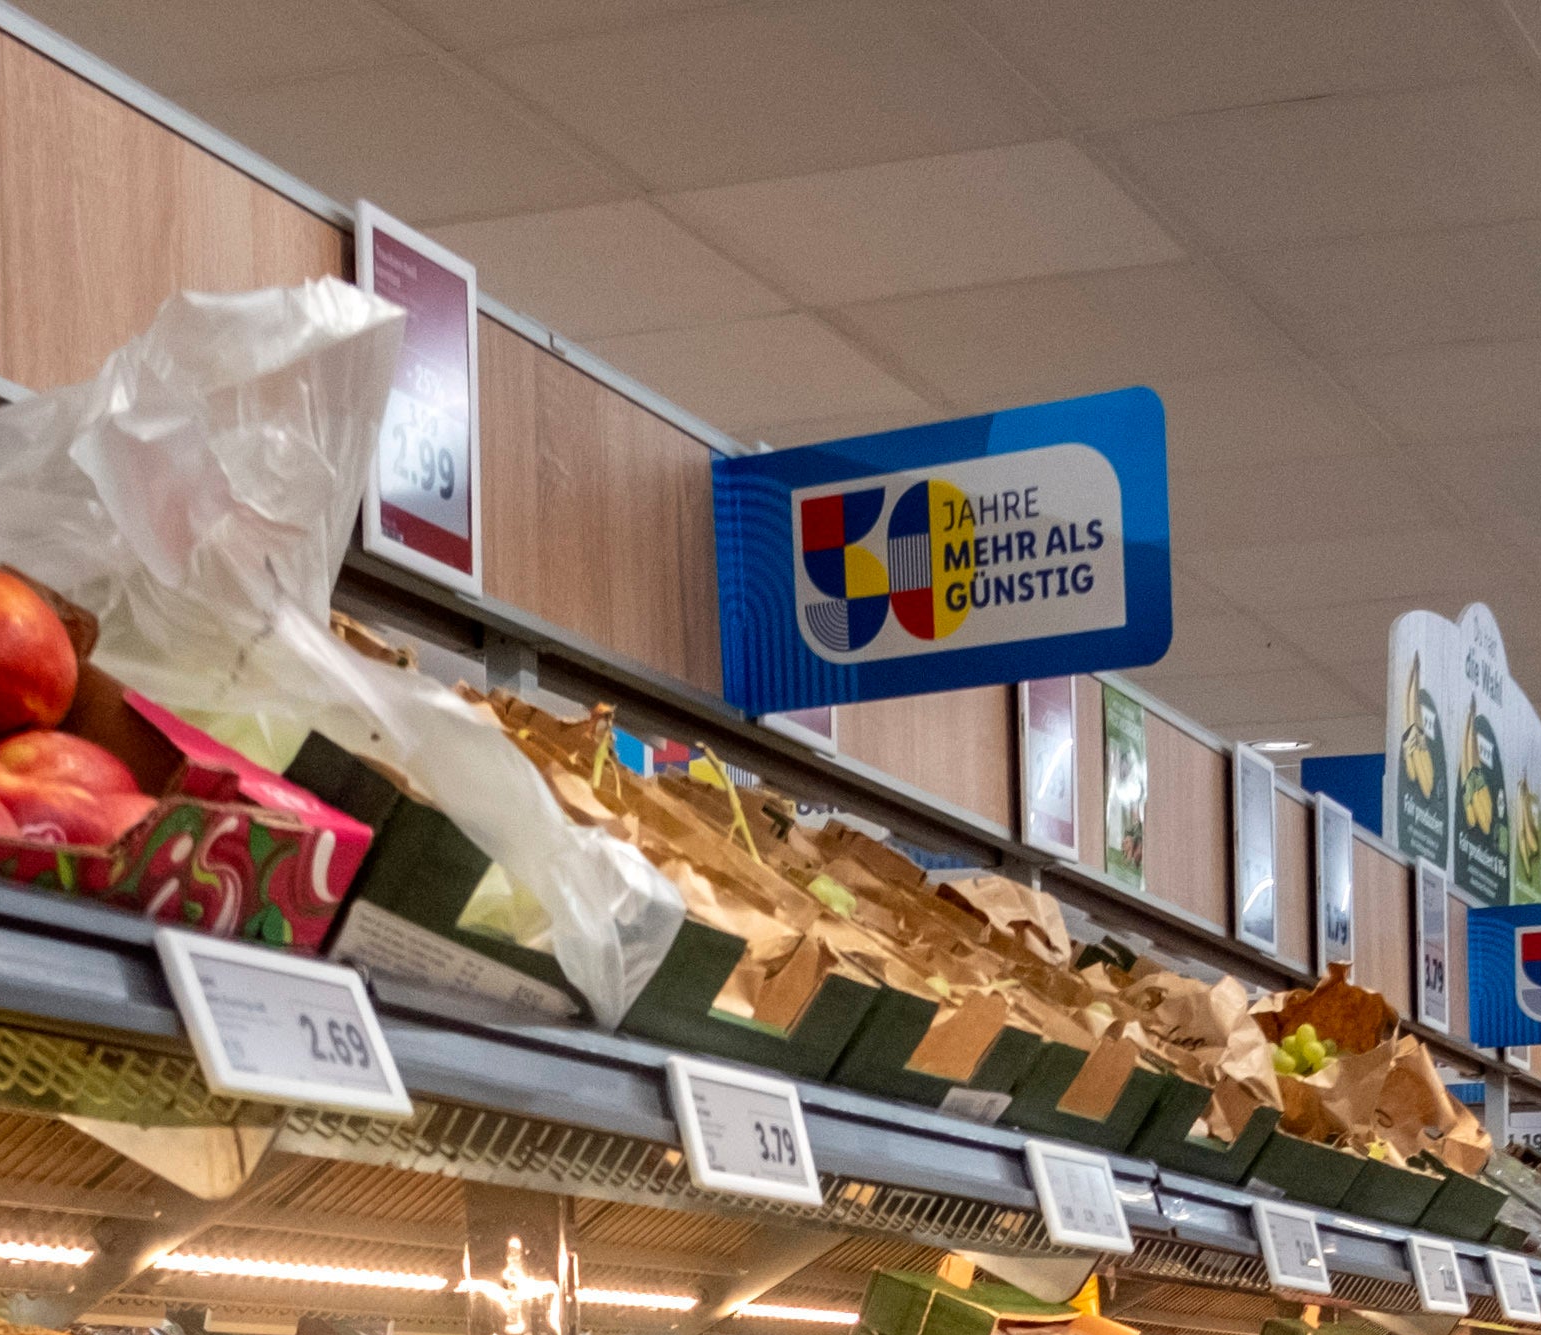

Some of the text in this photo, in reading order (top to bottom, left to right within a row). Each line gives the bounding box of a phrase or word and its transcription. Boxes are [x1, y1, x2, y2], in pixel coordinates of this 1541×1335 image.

[392, 423, 455, 500] 2.99
[943, 485, 1040, 532] JAHRE
[943, 518, 1104, 573] MEHR ALS
[945, 562, 1095, 612] GÜNSTIG
[298, 1013, 370, 1069] 2.69
[755, 1121, 796, 1166] 3.79
